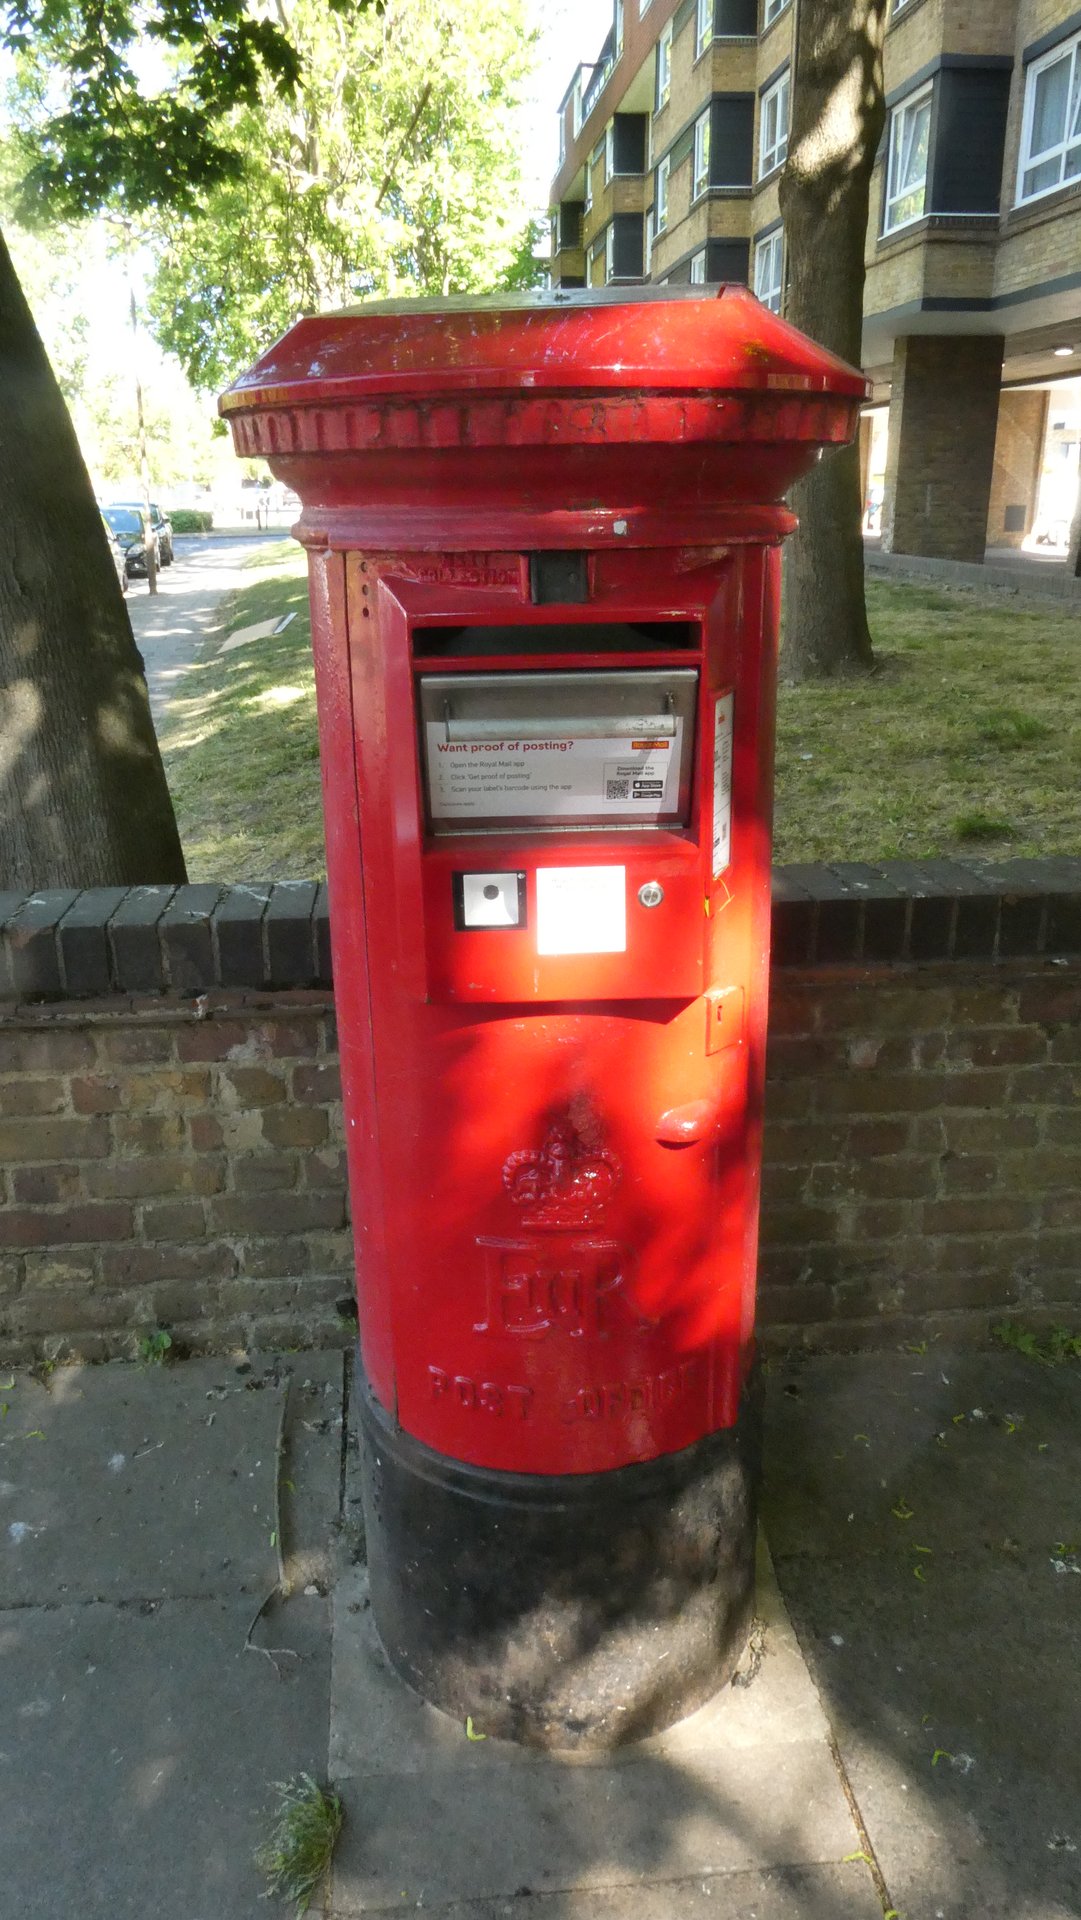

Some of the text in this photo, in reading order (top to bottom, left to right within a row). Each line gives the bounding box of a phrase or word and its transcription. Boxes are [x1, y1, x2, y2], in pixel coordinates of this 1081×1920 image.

[437, 740, 574, 754] Want proof of posting?
[450, 761, 467, 769] Open
[480, 760, 498, 768] Royal
[499, 760, 512, 768] Mail
[513, 761, 525, 769] app
[450, 773, 465, 781] Click
[451, 785, 467, 793] Scan
[504, 784, 530, 792] barcode
[530, 783, 548, 791] using
[549, 783, 560, 791] the
[560, 784, 573, 792] app
[428, 1363, 536, 1421] POST
